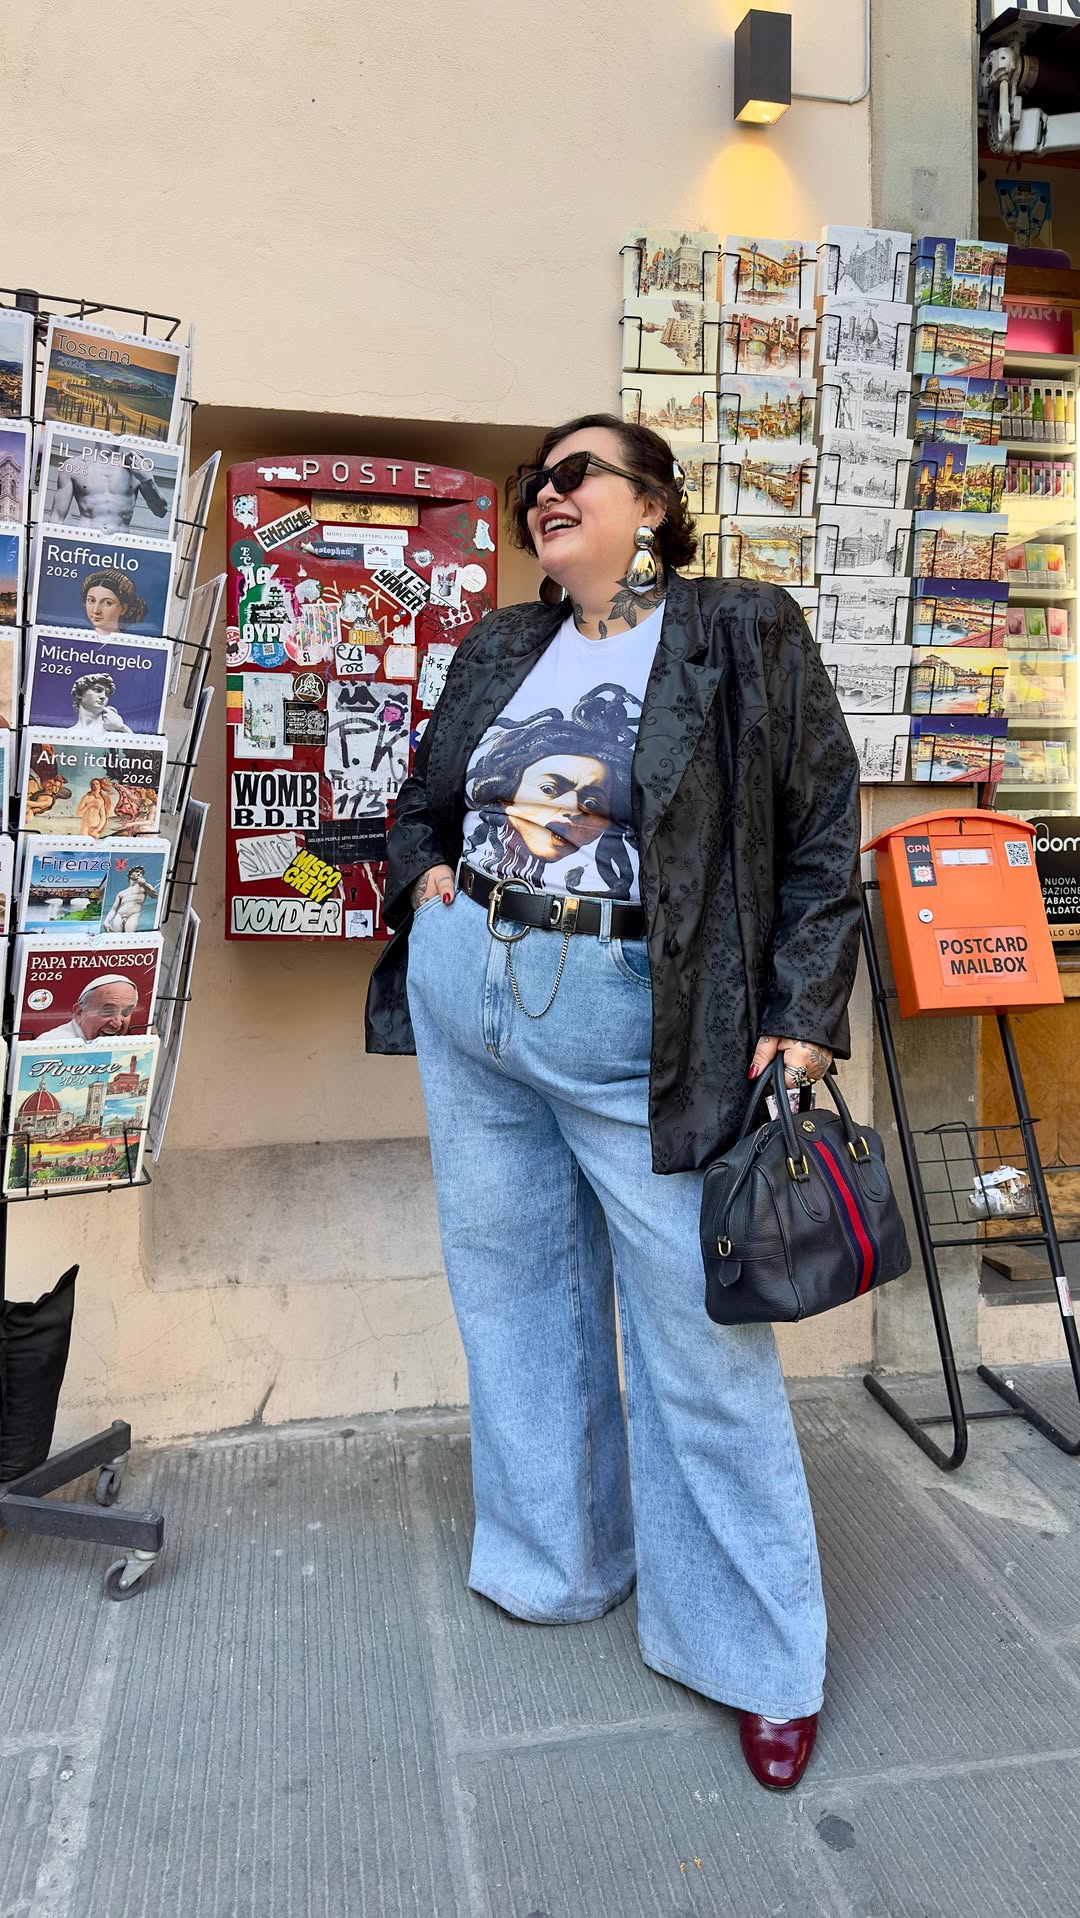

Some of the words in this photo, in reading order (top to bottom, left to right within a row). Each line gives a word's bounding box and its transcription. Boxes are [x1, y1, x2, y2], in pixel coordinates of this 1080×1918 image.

[56, 333, 132, 366] Toscana
[56, 355, 88, 372] 2026
[58, 441, 75, 458] IL
[81, 445, 155, 473] PISELLO
[57, 462, 89, 478] 2026
[302, 459, 432, 490] POSTE
[47, 544, 140, 572] Raffaello
[46, 564, 79, 580] 2026
[41, 644, 153, 672] Michelangelo
[40, 662, 73, 676] 2026
[36, 750, 78, 768] Arte
[84, 752, 153, 771] italiana
[122, 773, 153, 785] 2026
[234, 773, 317, 808] WOMB
[234, 808, 317, 828] B.D.R
[907, 844, 930, 853] GPN
[40, 856, 112, 872] Firenze
[291, 850, 342, 888] MISCO
[39, 874, 70, 884] 2026
[283, 867, 333, 903] CREW
[1045, 877, 1077, 886] NUOVA
[1042, 887, 1080, 896] SAZIONE
[234, 898, 340, 933] VOYDER
[940, 936, 1028, 955] POSTCARD
[30, 955, 67, 971] PAPA
[69, 953, 155, 969] FRANCESCO
[950, 957, 1027, 975] MAILBOX
[30, 971, 62, 982] 2026
[28, 1058, 122, 1078] Firenze
